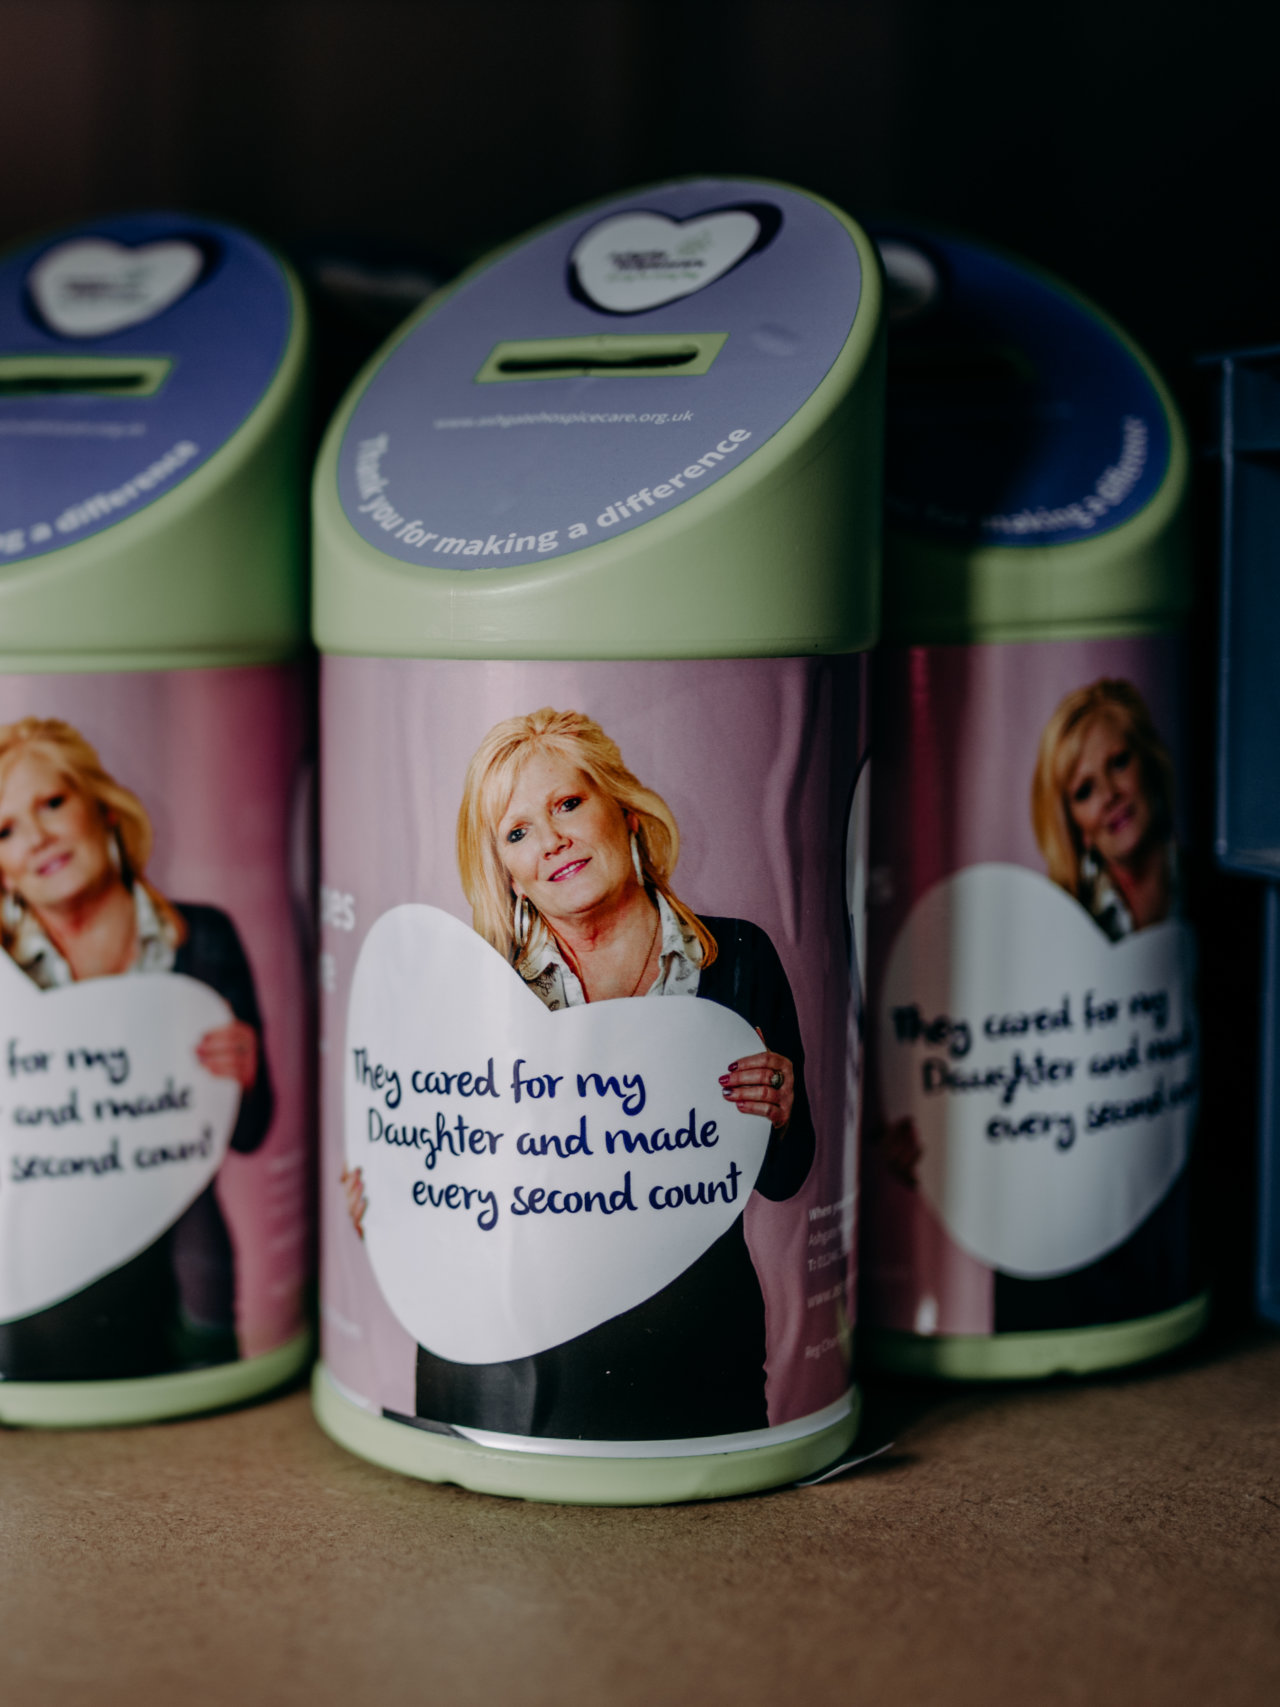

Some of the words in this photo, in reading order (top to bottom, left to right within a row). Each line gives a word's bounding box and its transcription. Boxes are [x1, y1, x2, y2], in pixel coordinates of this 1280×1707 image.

[30, 522, 53, 542] a
[55, 439, 200, 534] difference
[356, 432, 389, 501] Thank
[596, 428, 753, 528] difference
[358, 494, 405, 532] you
[394, 519, 439, 548] for
[568, 522, 589, 540] a
[432, 531, 559, 556] making
[1084, 990, 1120, 1029] for
[5, 1037, 53, 1079] for
[66, 1045, 131, 1086] my
[352, 1047, 402, 1109] They
[411, 1057, 500, 1097] cared
[510, 1059, 564, 1103] for
[577, 1073, 646, 1116] my
[14, 1086, 82, 1129] and
[94, 1076, 194, 1122] made
[368, 1107, 504, 1170] Daughter
[516, 1115, 594, 1159] and
[606, 1108, 719, 1155] made
[986, 1114, 1077, 1153] every
[11, 1138, 124, 1184] second
[412, 1179, 499, 1231] every
[510, 1171, 637, 1215] second
[649, 1162, 743, 1208] count
